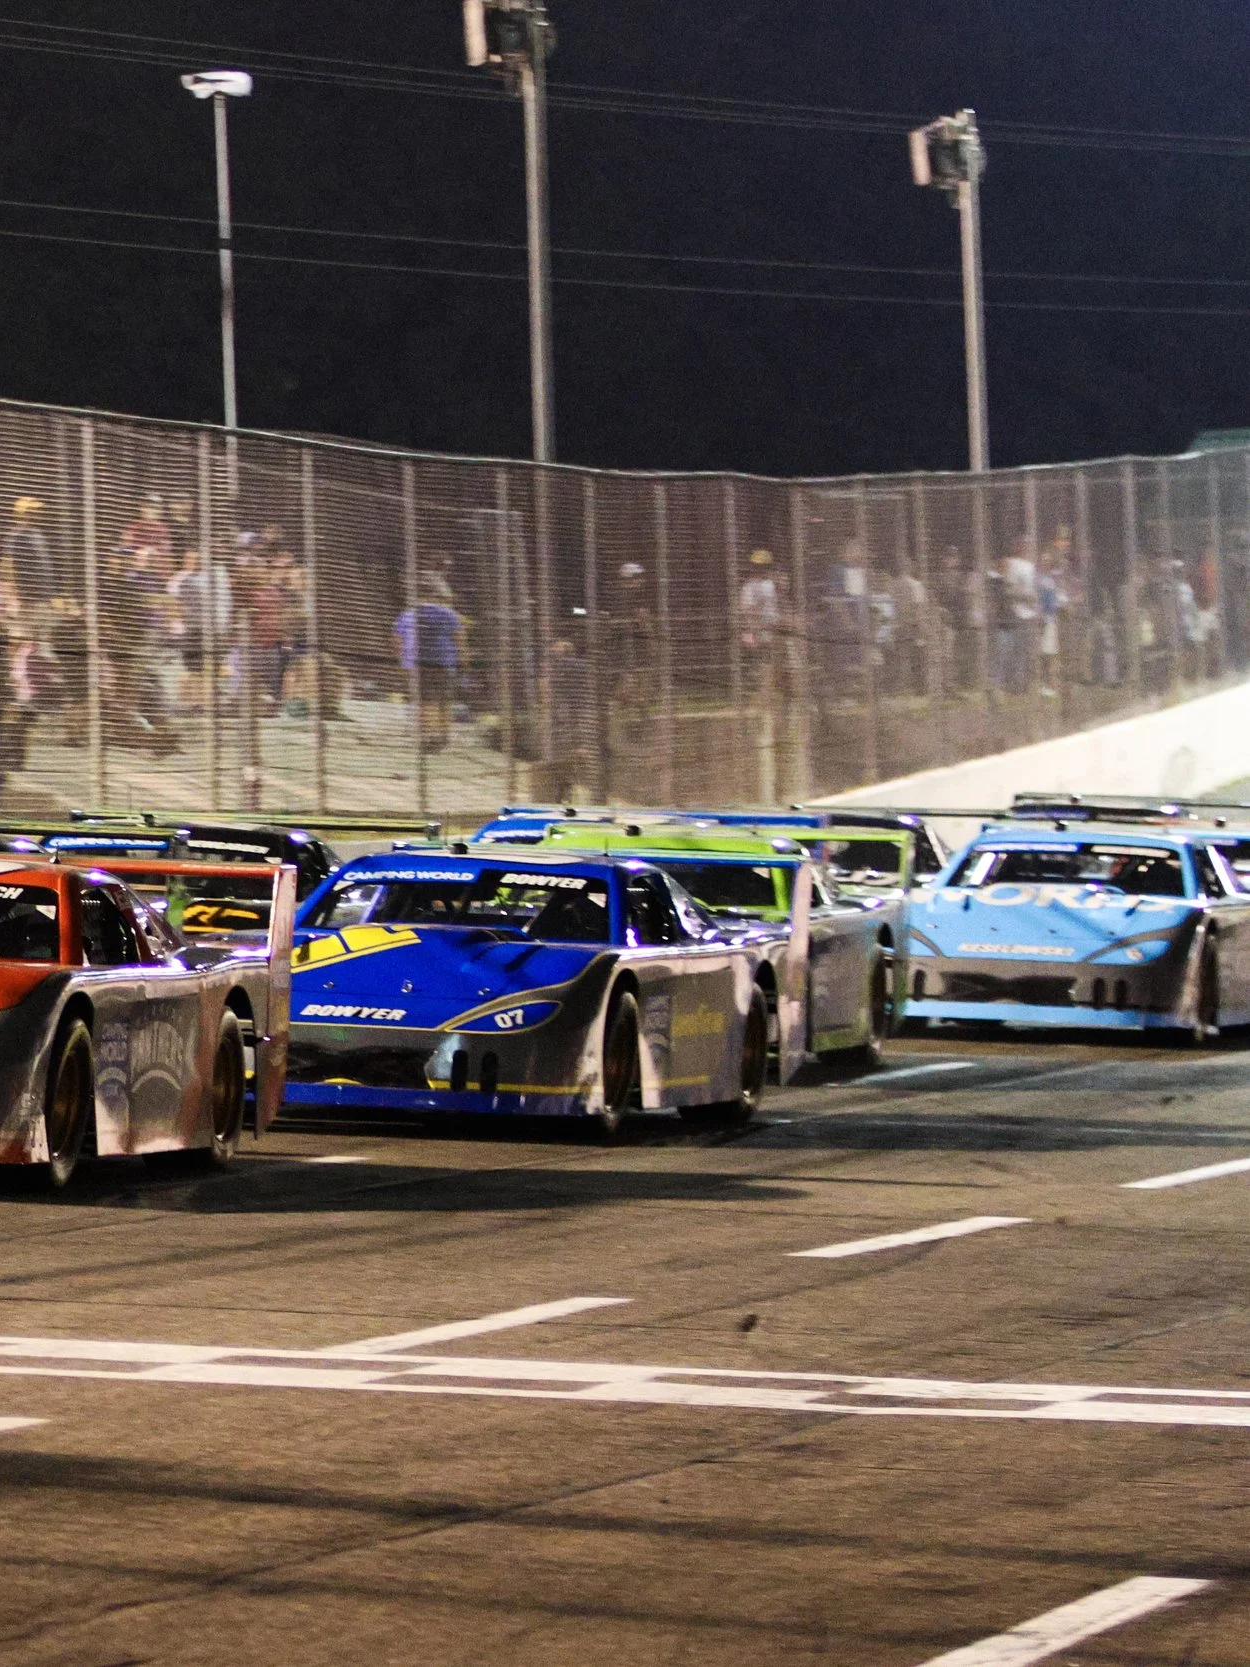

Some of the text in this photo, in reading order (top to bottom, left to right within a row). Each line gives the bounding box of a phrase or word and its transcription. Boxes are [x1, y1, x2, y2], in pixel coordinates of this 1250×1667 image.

[343, 871, 475, 881] CAMPING WORLD
[500, 873, 587, 890] BOWYER
[300, 1003, 407, 1021] BOWYER
[493, 1008, 524, 1028] 07
